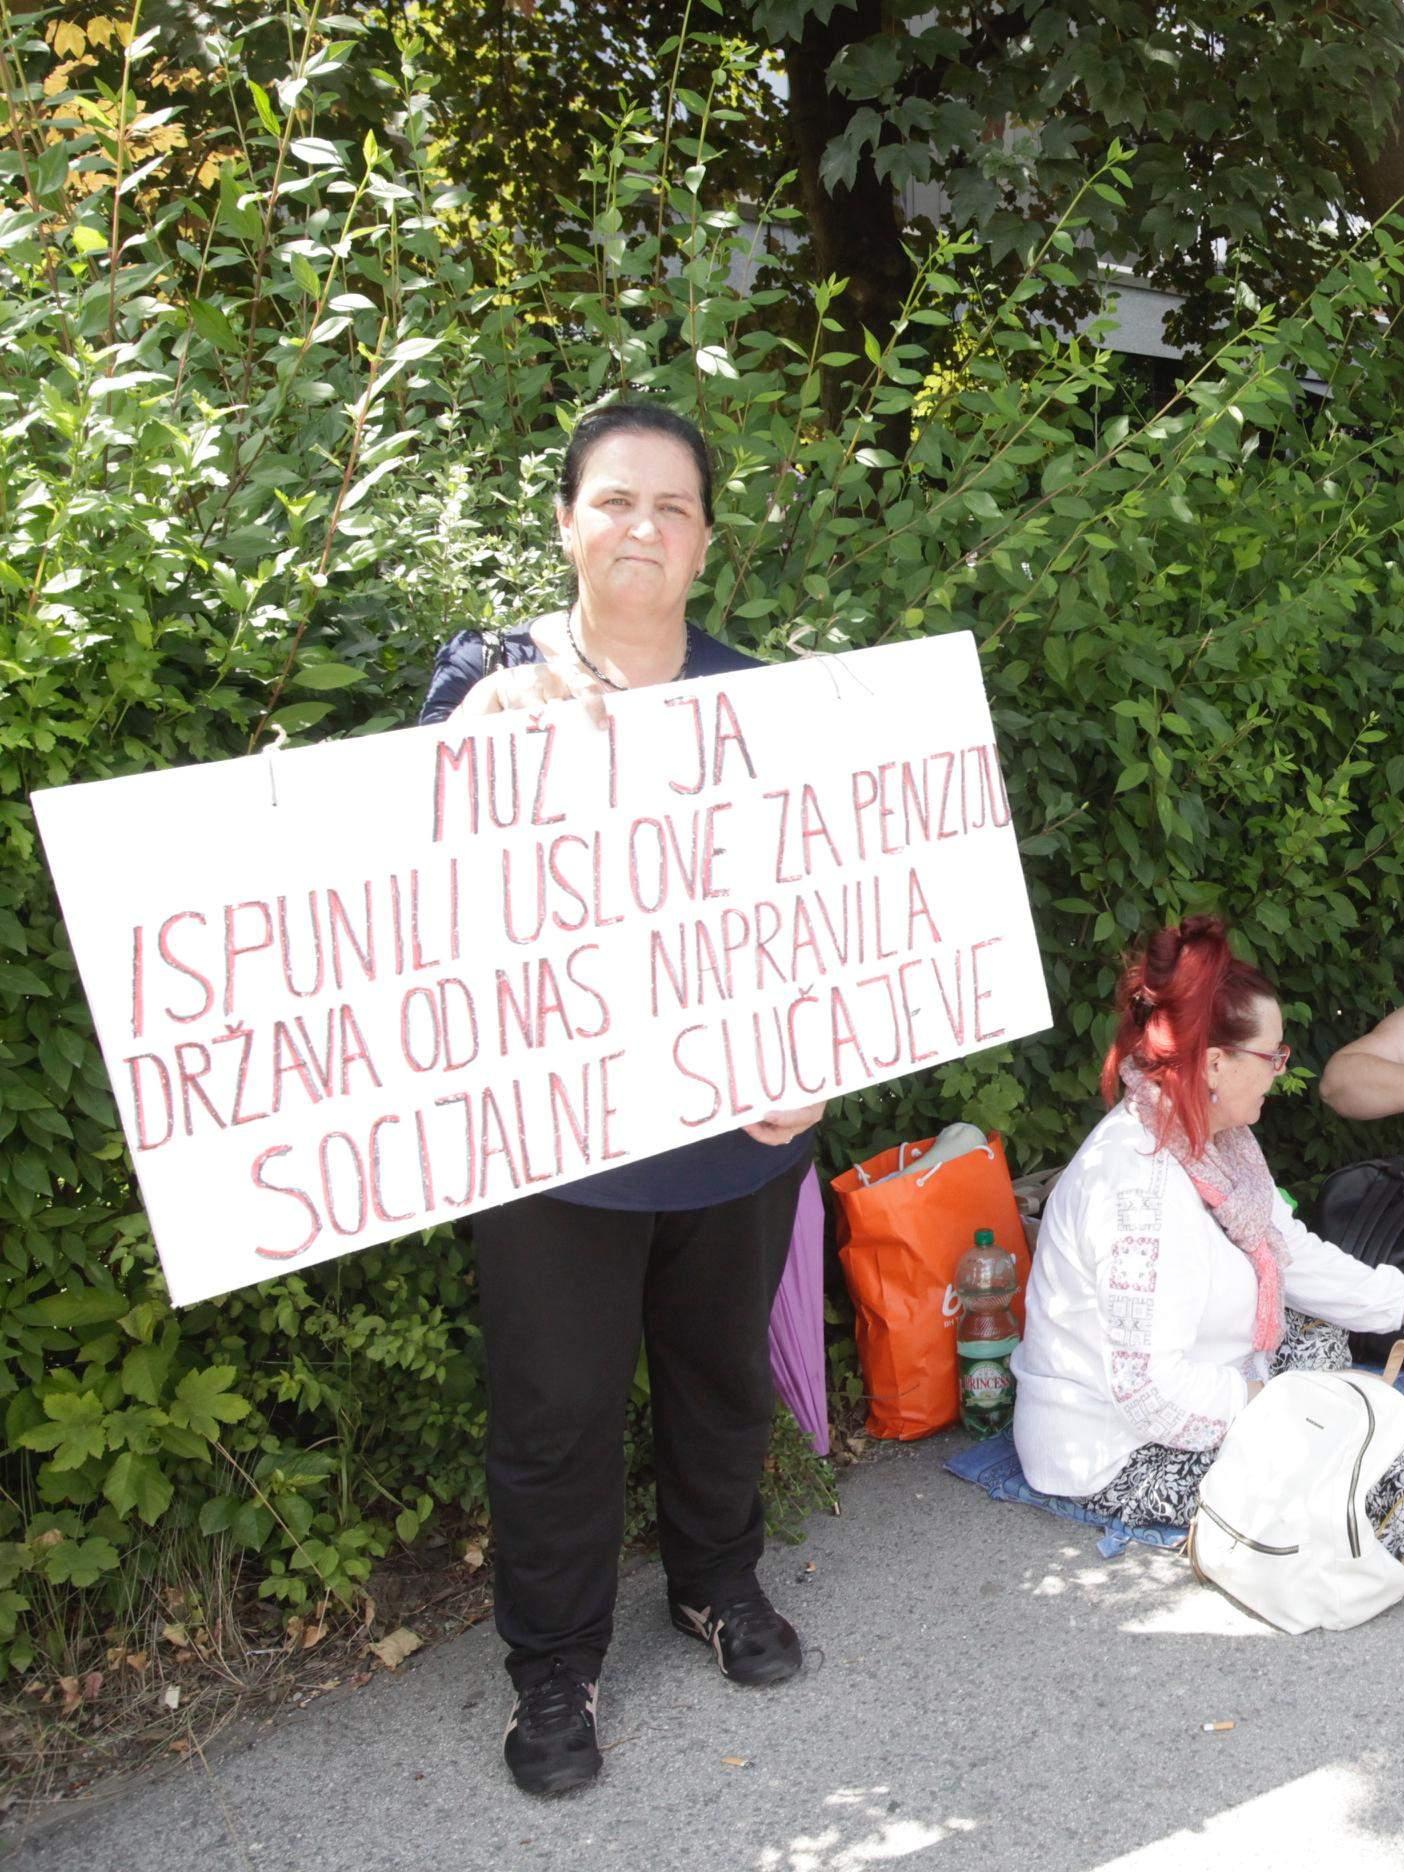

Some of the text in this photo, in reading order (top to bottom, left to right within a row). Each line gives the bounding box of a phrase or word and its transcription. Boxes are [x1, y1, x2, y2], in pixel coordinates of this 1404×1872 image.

[131, 743, 1011, 1039] ISPUNILI USLOVE ZA PENZIJU
[432, 691, 757, 842] MUŽ I JA
[123, 867, 942, 1151] DRŽAVA OD NAS NAPRAVILA
[251, 936, 1006, 1261] SOCIJALNE SLUČAJEVE
